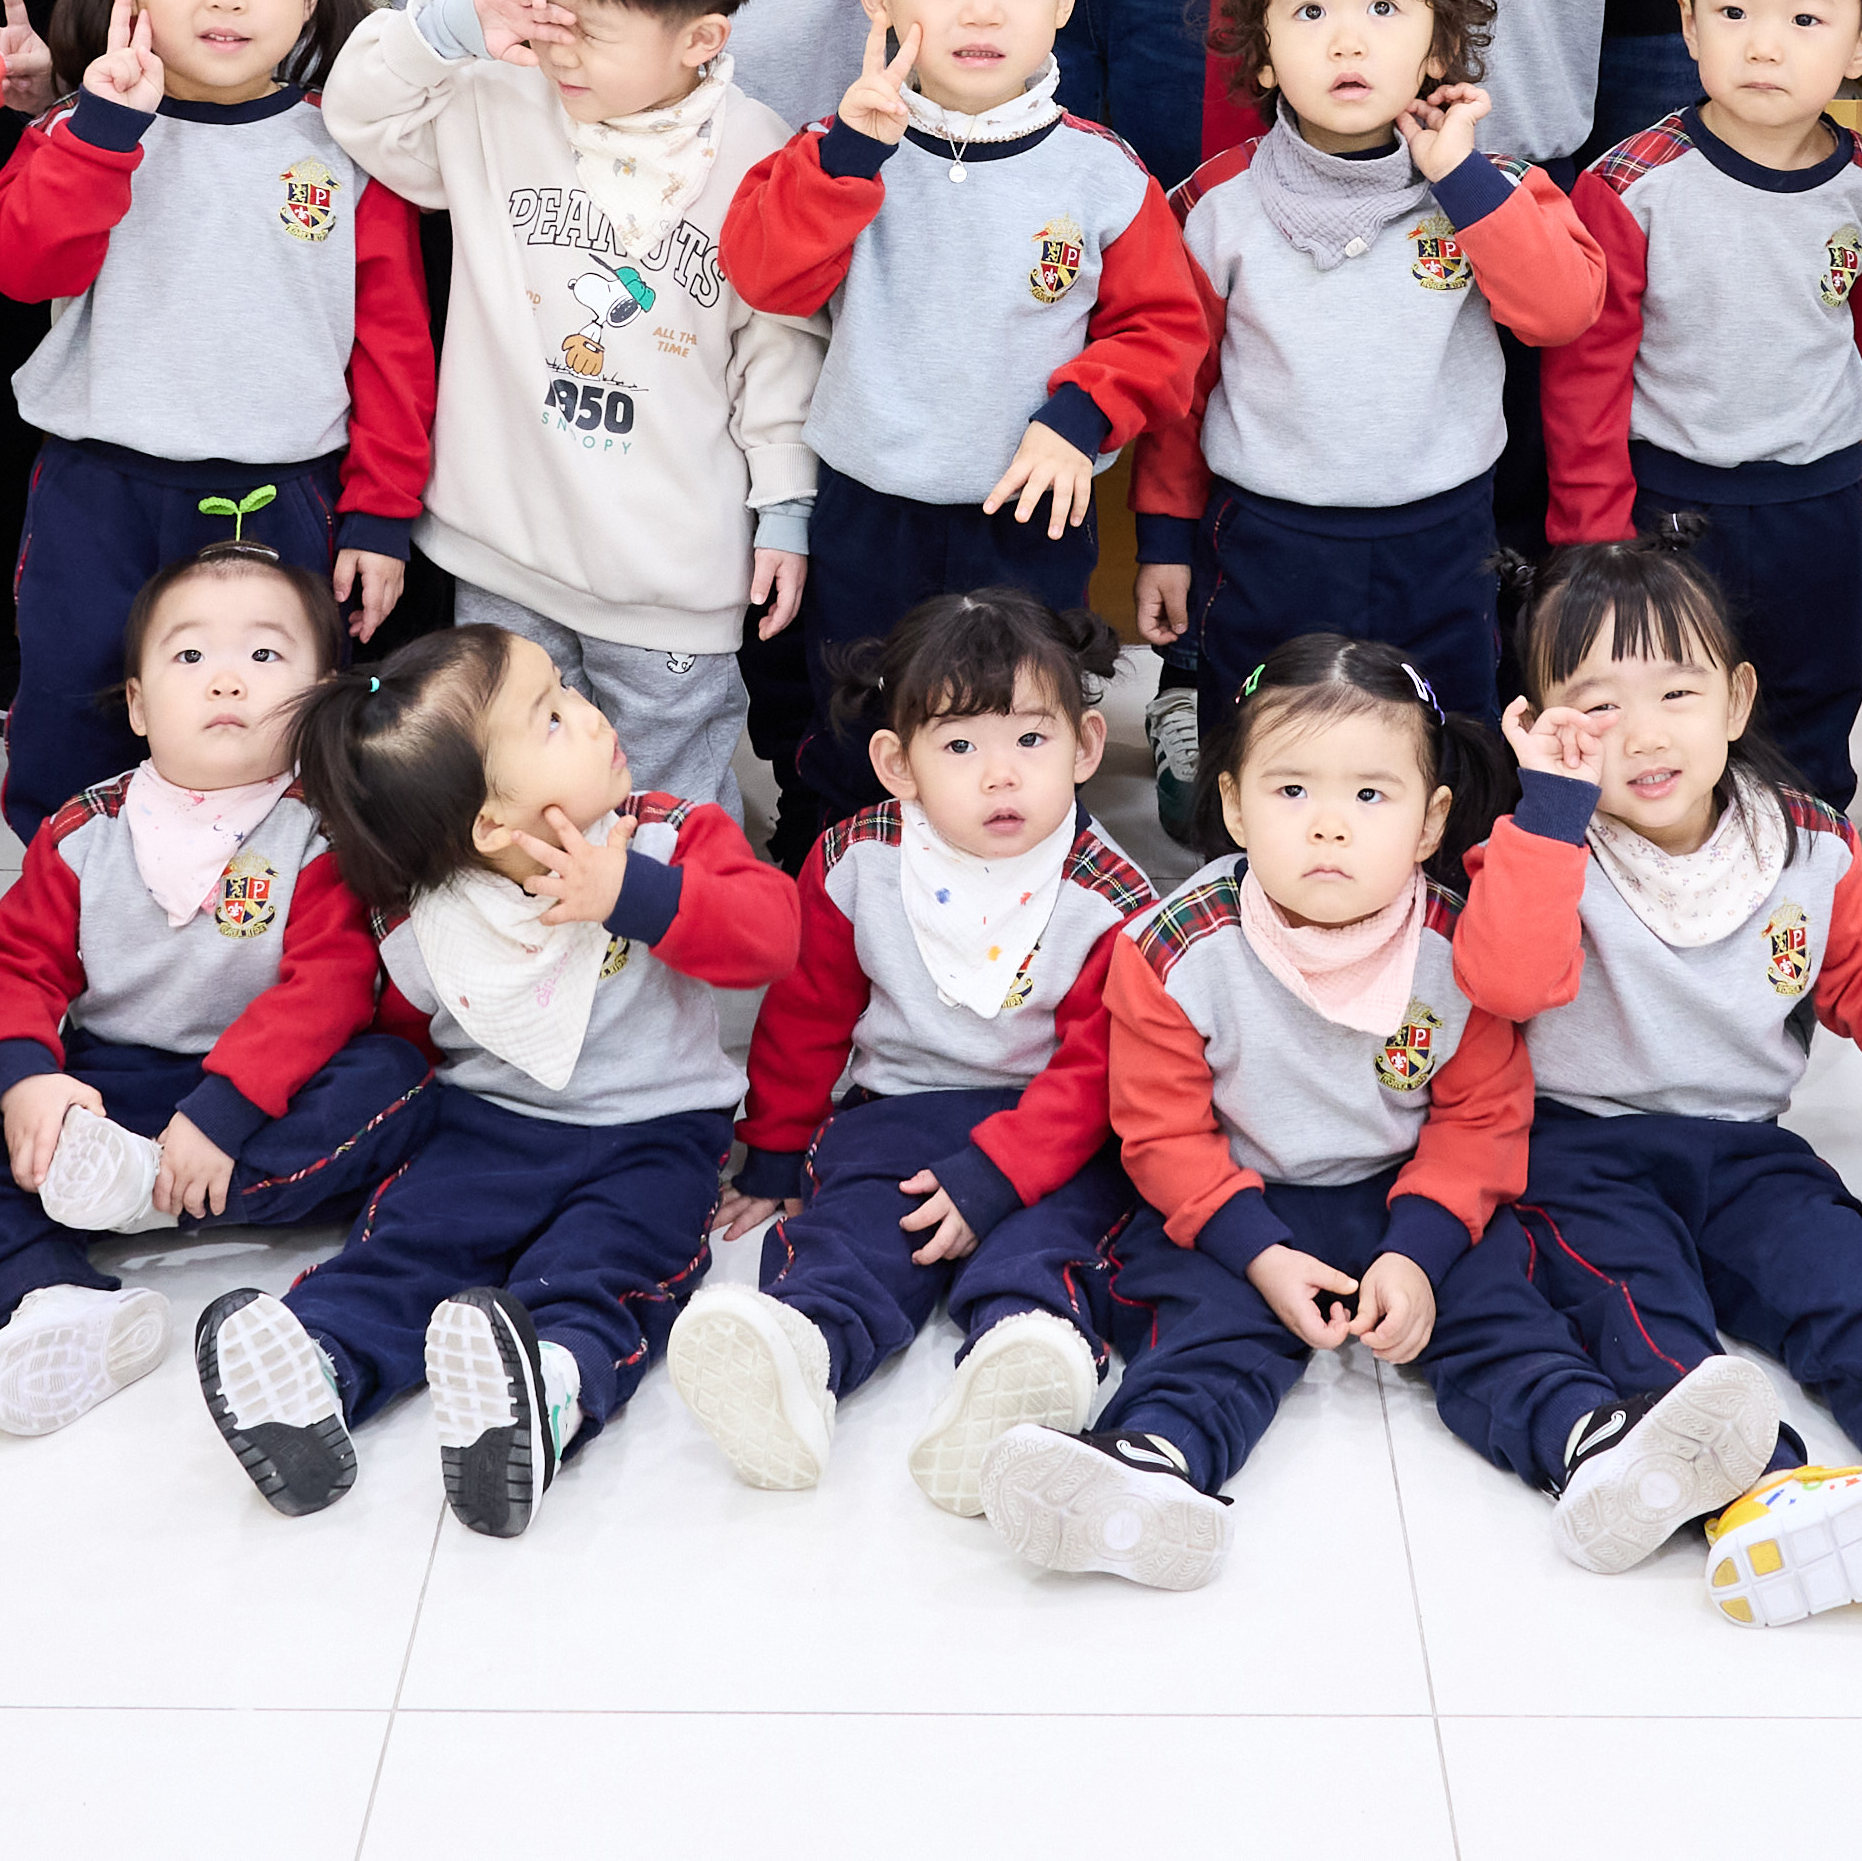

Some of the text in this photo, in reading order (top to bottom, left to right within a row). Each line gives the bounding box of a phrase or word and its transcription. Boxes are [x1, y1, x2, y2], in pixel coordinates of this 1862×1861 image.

[652, 326, 698, 346] ALL TH
[657, 340, 690, 358] TIME
[544, 378, 635, 435] 1950
[541, 411, 632, 455] SNOPY
